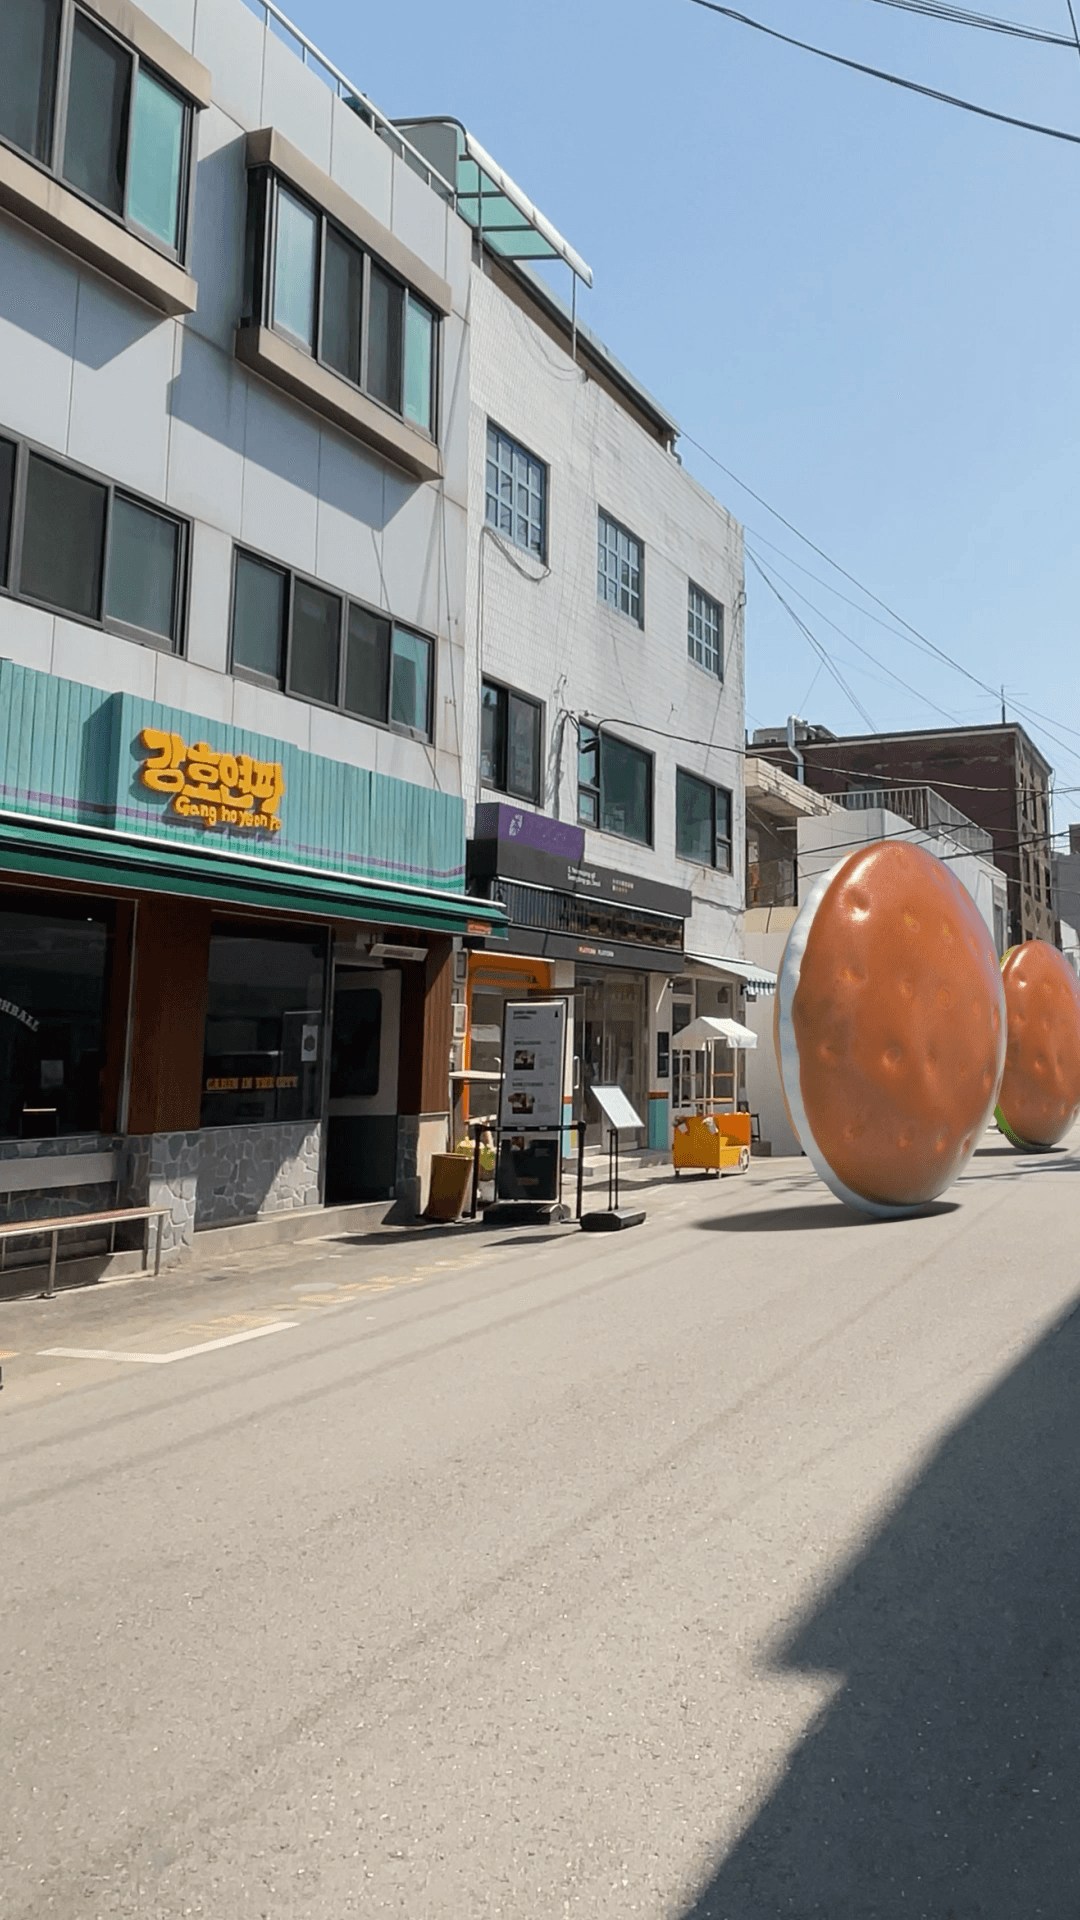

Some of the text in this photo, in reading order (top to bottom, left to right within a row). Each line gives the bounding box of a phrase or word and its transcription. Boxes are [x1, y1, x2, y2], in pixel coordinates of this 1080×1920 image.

[175, 796, 217, 826] Gang
[221, 805, 237, 823] ho
[0, 997, 40, 1032] HBALL
